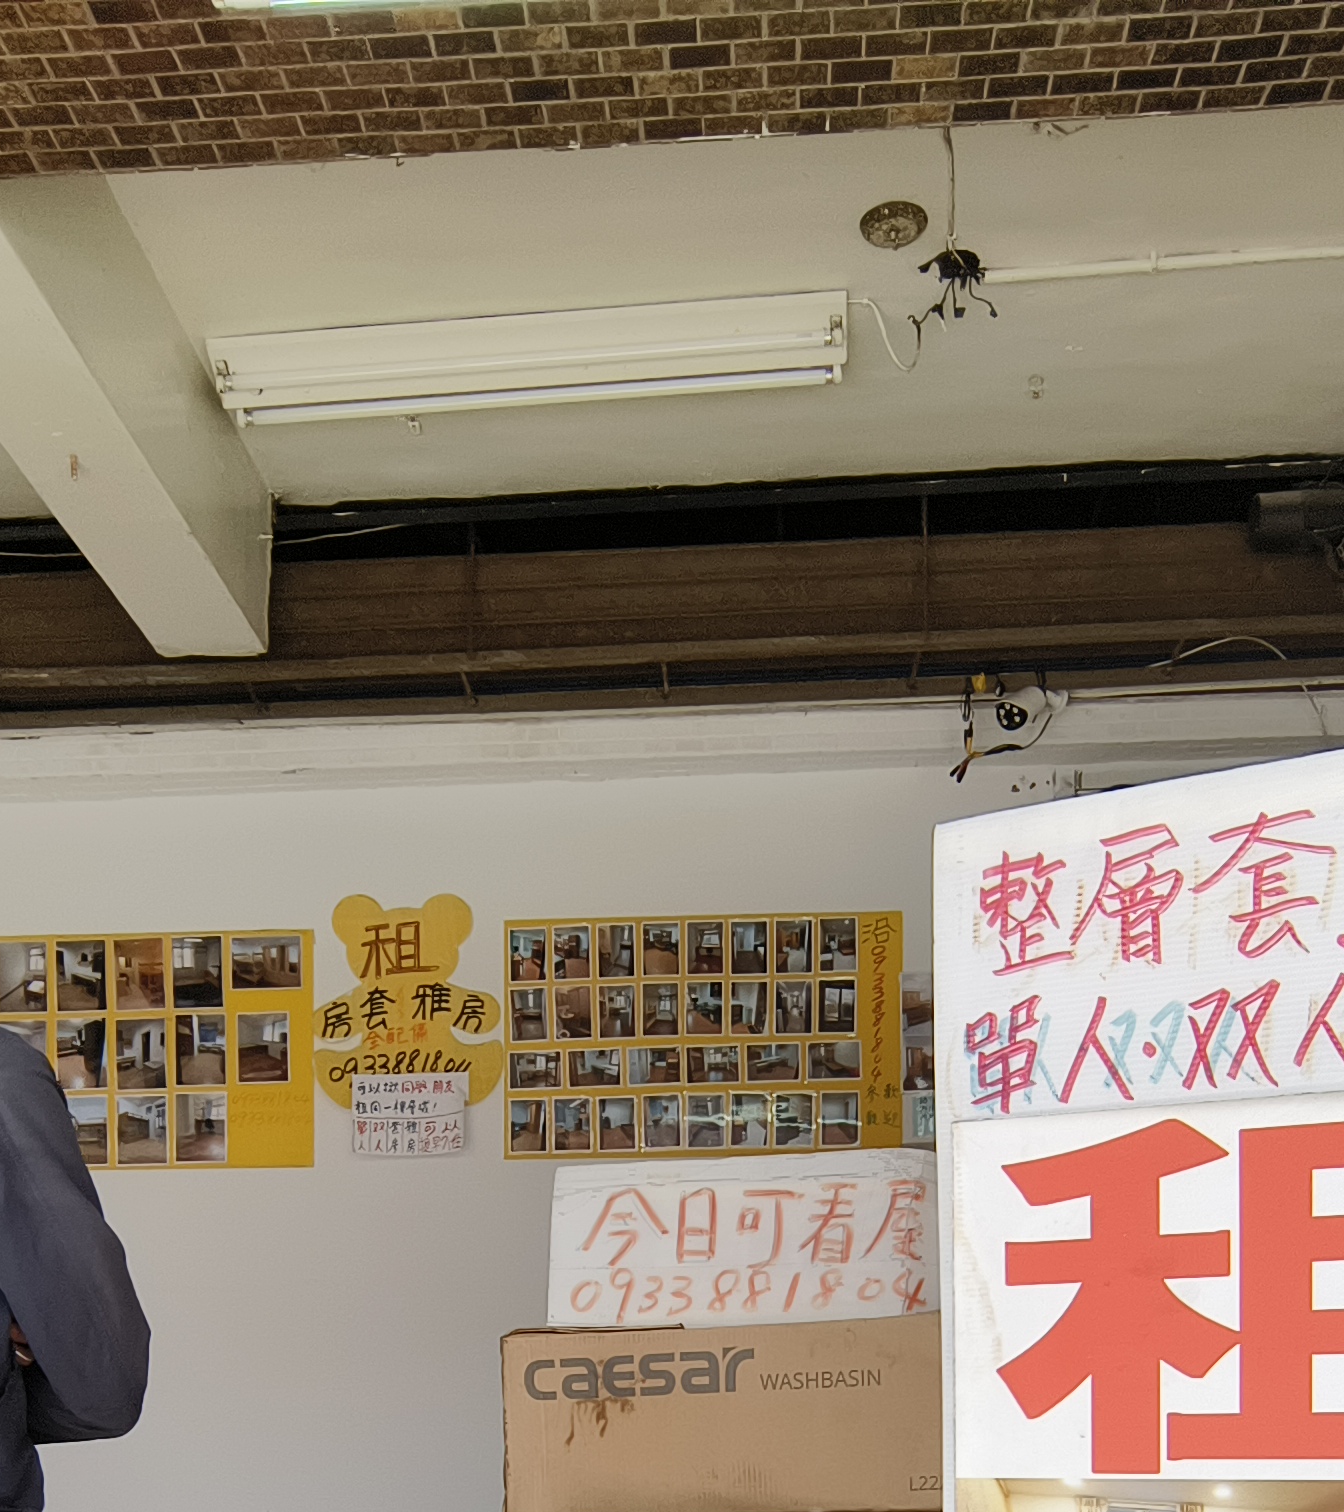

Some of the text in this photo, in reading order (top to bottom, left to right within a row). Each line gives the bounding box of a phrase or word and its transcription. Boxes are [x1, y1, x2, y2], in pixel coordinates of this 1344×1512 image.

[359, 920, 441, 980] 租
[575, 1179, 927, 1271] 今日可看屋
[523, 1345, 883, 1402] caesar WASHBASIN
